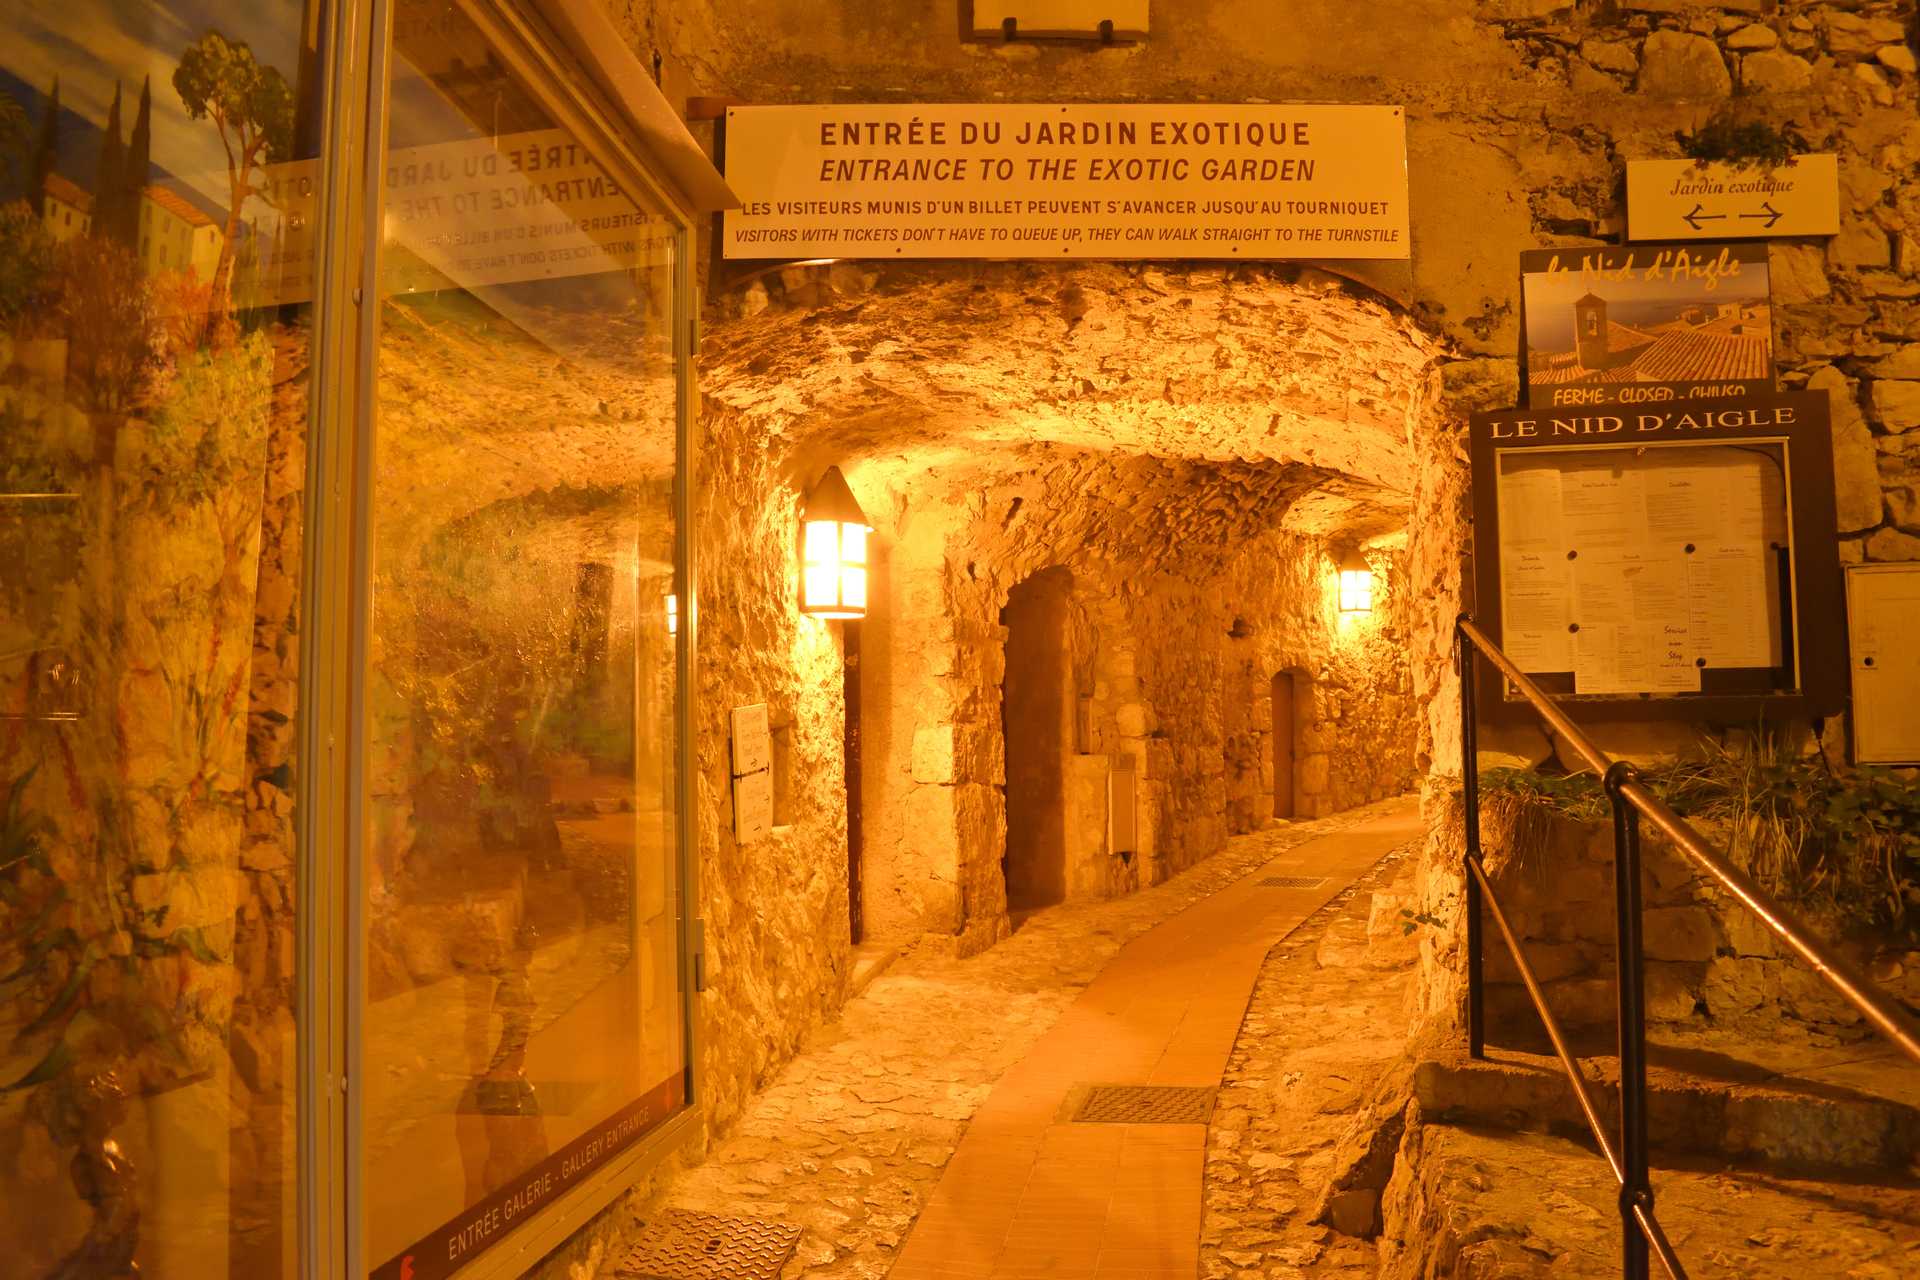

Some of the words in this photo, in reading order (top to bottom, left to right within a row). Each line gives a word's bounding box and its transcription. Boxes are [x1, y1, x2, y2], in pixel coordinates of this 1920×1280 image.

[821, 117, 946, 145] ENTRÉE
[961, 122, 1001, 145] DU
[1015, 122, 1136, 145] JARDIN
[1150, 122, 1310, 147] EXOTIQUE
[819, 158, 967, 182] ENTRANCE
[980, 158, 1014, 181] TO
[1027, 158, 1078, 181] THE
[1088, 158, 1190, 181] EXOTIC
[1202, 158, 1315, 182] GARDEN
[1670, 176, 1723, 196] Jardin
[1728, 176, 1794, 197] exotique
[742, 203, 771, 216] LES
[777, 201, 862, 216] VISITEURS
[868, 201, 921, 216] MUNIS
[927, 201, 964, 216] D'UN
[968, 201, 1023, 216] BILLET
[1028, 201, 1101, 216] PEUVENT
[1107, 201, 1196, 216] S'AVANCER
[1202, 201, 1281, 216] JUSQU'AU
[1287, 201, 1389, 216] TOURNIQUET
[736, 229, 798, 242] VISITORS
[802, 228, 838, 241] WITH
[843, 228, 898, 241] TICKETS
[902, 228, 946, 241] DON'T
[949, 228, 985, 241] HAVE
[990, 228, 1008, 241] TO
[1012, 228, 1058, 241] QUEUE
[1062, 228, 1082, 243] UP,
[1087, 228, 1121, 241] THEY
[1125, 228, 1154, 241] CAN
[1158, 228, 1198, 241] WALK
[1202, 228, 1271, 241] STRAIGHT
[1275, 228, 1293, 241] TO
[1297, 228, 1322, 241] THE
[1327, 228, 1399, 242] TURNSTILE
[1645, 247, 1741, 290] d'Aigle
[1554, 387, 1605, 406] FERME
[1619, 386, 1674, 404] CLOSED
[1490, 420, 1539, 438] LE
[1551, 415, 1624, 436] NID
[1636, 407, 1797, 432] D'AIGLE
[449, 1207, 500, 1261] ENTRÉE
[504, 1172, 552, 1221] GALERIE
[562, 1137, 604, 1180] GALLERY
[606, 1105, 650, 1149] ENTRANCE
